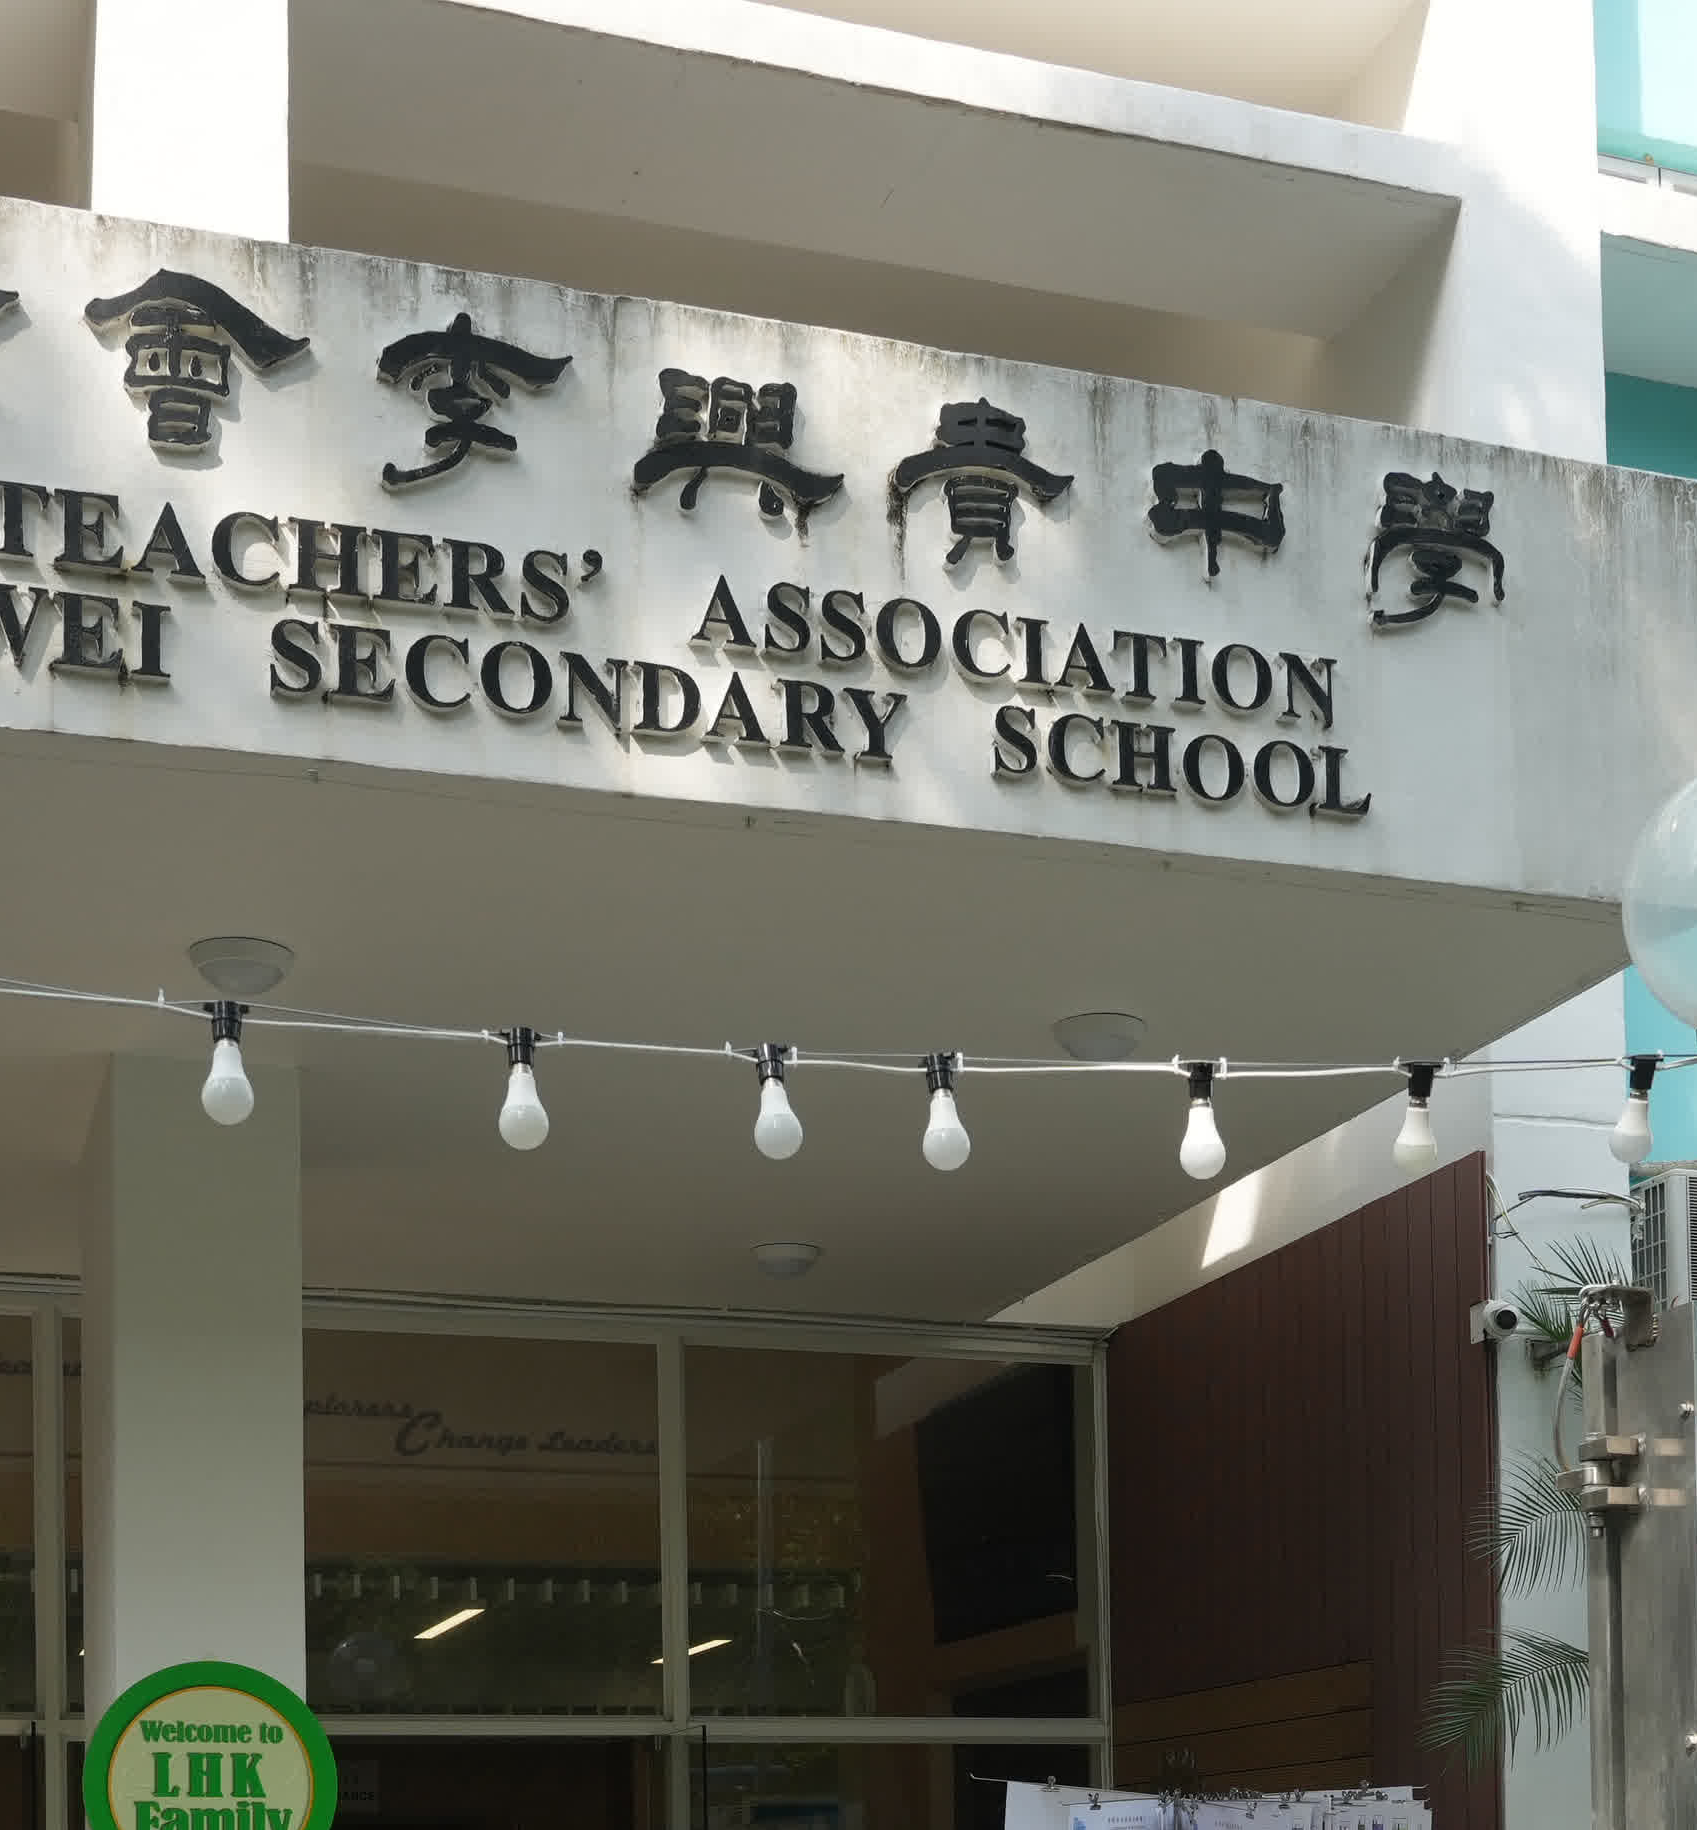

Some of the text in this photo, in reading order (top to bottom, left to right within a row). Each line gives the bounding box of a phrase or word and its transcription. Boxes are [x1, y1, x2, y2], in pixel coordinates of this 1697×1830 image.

[690, 574, 1339, 730] ASSOCIATION
[269, 617, 908, 763] SECONDARY
[990, 705, 1373, 818] SCHOOL
[393, 1407, 532, 1456] Change
[139, 1719, 284, 1745] Welcome to
